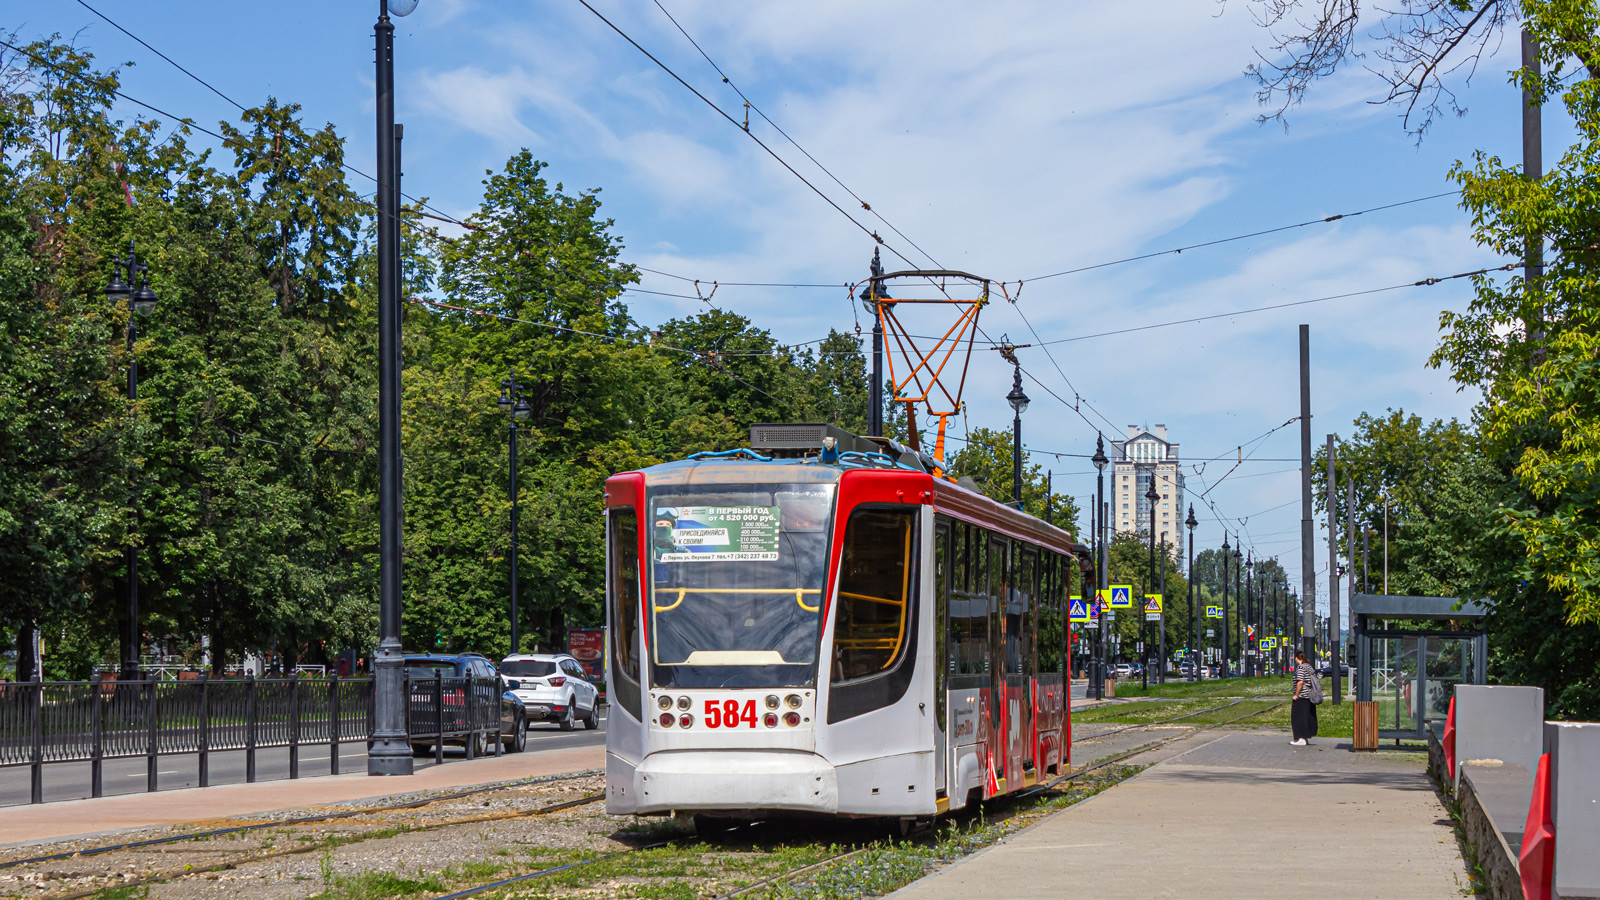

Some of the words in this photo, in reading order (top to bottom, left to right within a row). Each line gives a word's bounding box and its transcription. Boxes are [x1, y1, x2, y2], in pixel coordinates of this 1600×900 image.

[716, 506, 752, 515] ПЕРВЫЙ
[753, 507, 769, 515] ГОД
[759, 515, 777, 523] руб.
[679, 529, 725, 537] ПРИСОЕДИНЯЙСЯ
[704, 700, 758, 728] 584
